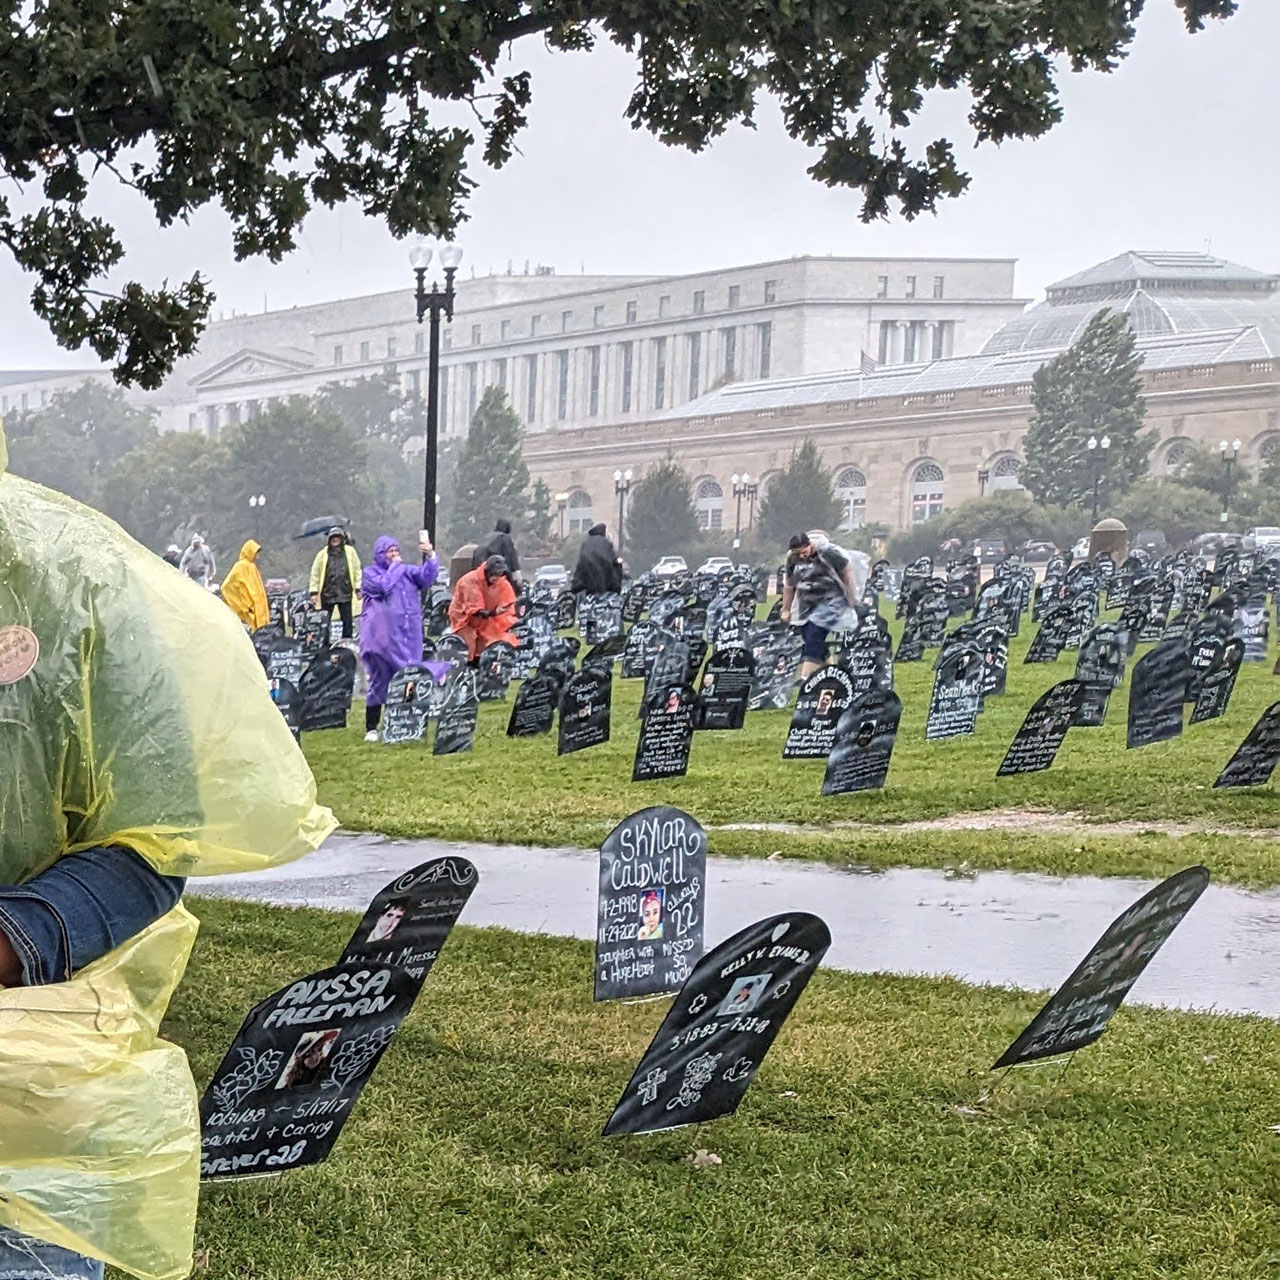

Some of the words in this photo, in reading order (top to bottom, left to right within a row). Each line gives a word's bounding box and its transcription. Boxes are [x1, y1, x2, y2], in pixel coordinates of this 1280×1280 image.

[200, 1126, 258, 1148] eautiful
[282, 1120, 334, 1139] Caring
[200, 1149, 270, 1175] orever
